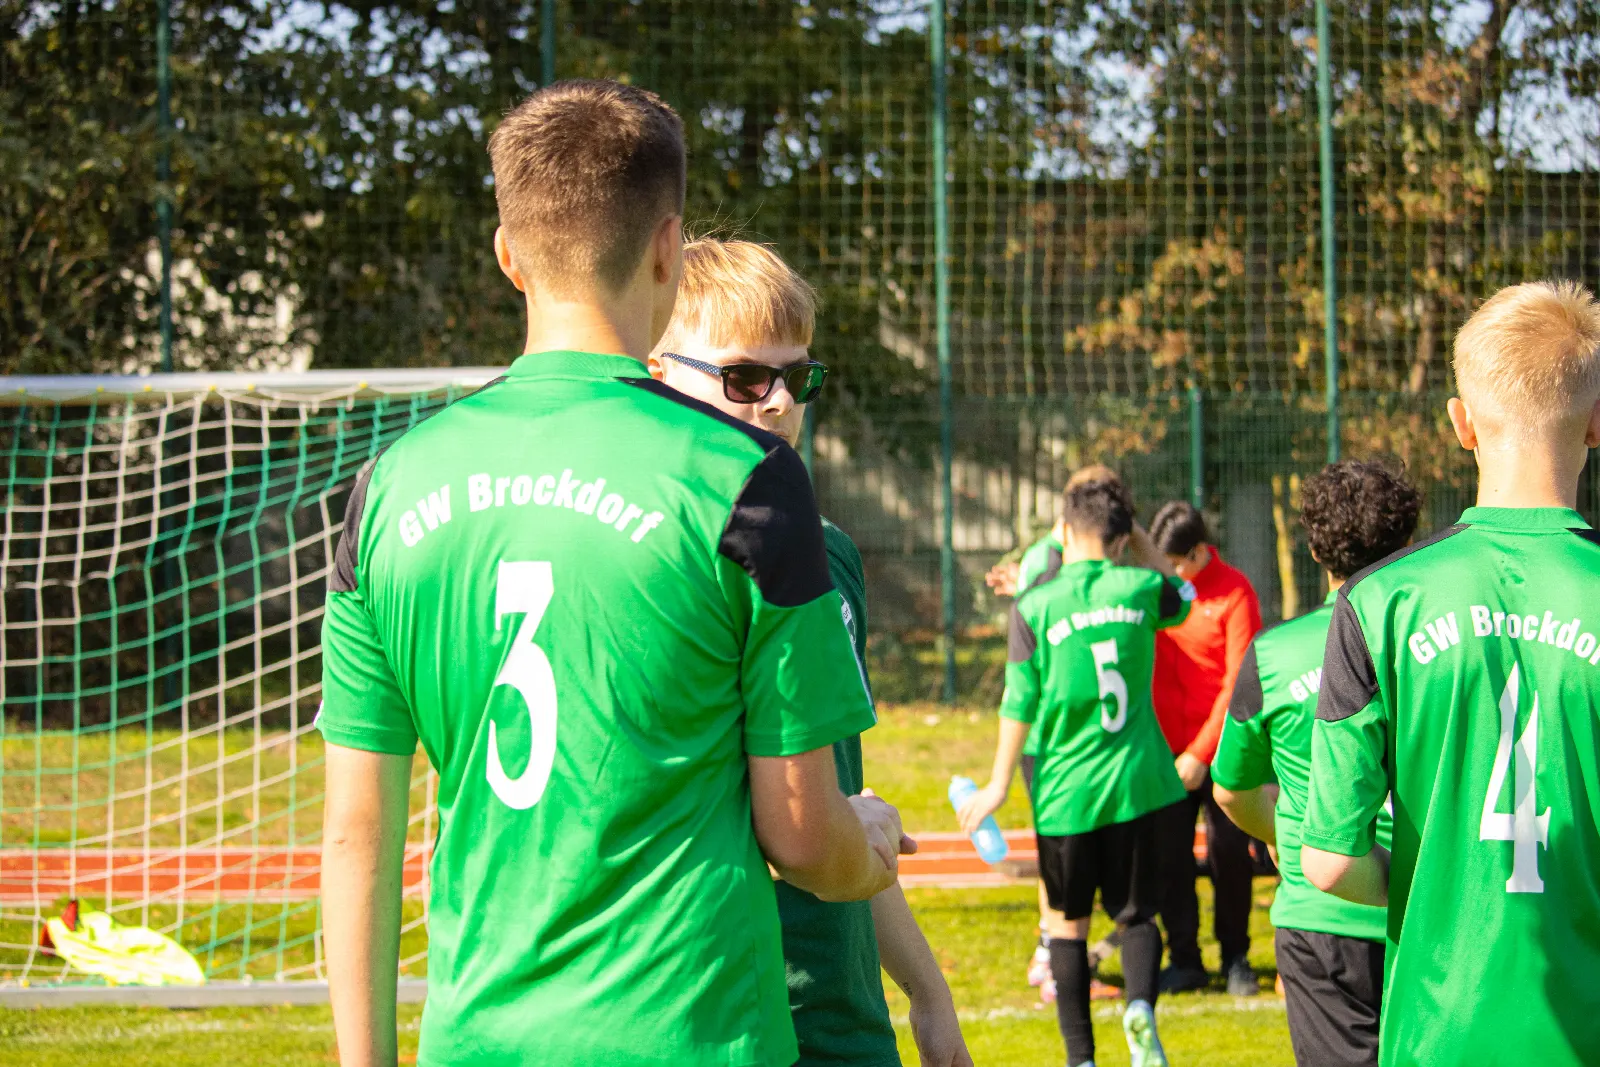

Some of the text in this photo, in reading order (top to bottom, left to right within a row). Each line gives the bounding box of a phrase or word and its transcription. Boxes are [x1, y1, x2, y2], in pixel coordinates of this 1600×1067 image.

[399, 469, 664, 547] GW Brockdorf
[486, 559, 558, 810] 3
[1090, 638, 1128, 733] 5
[1408, 612, 1460, 665] GW
[1479, 660, 1551, 893] 4
